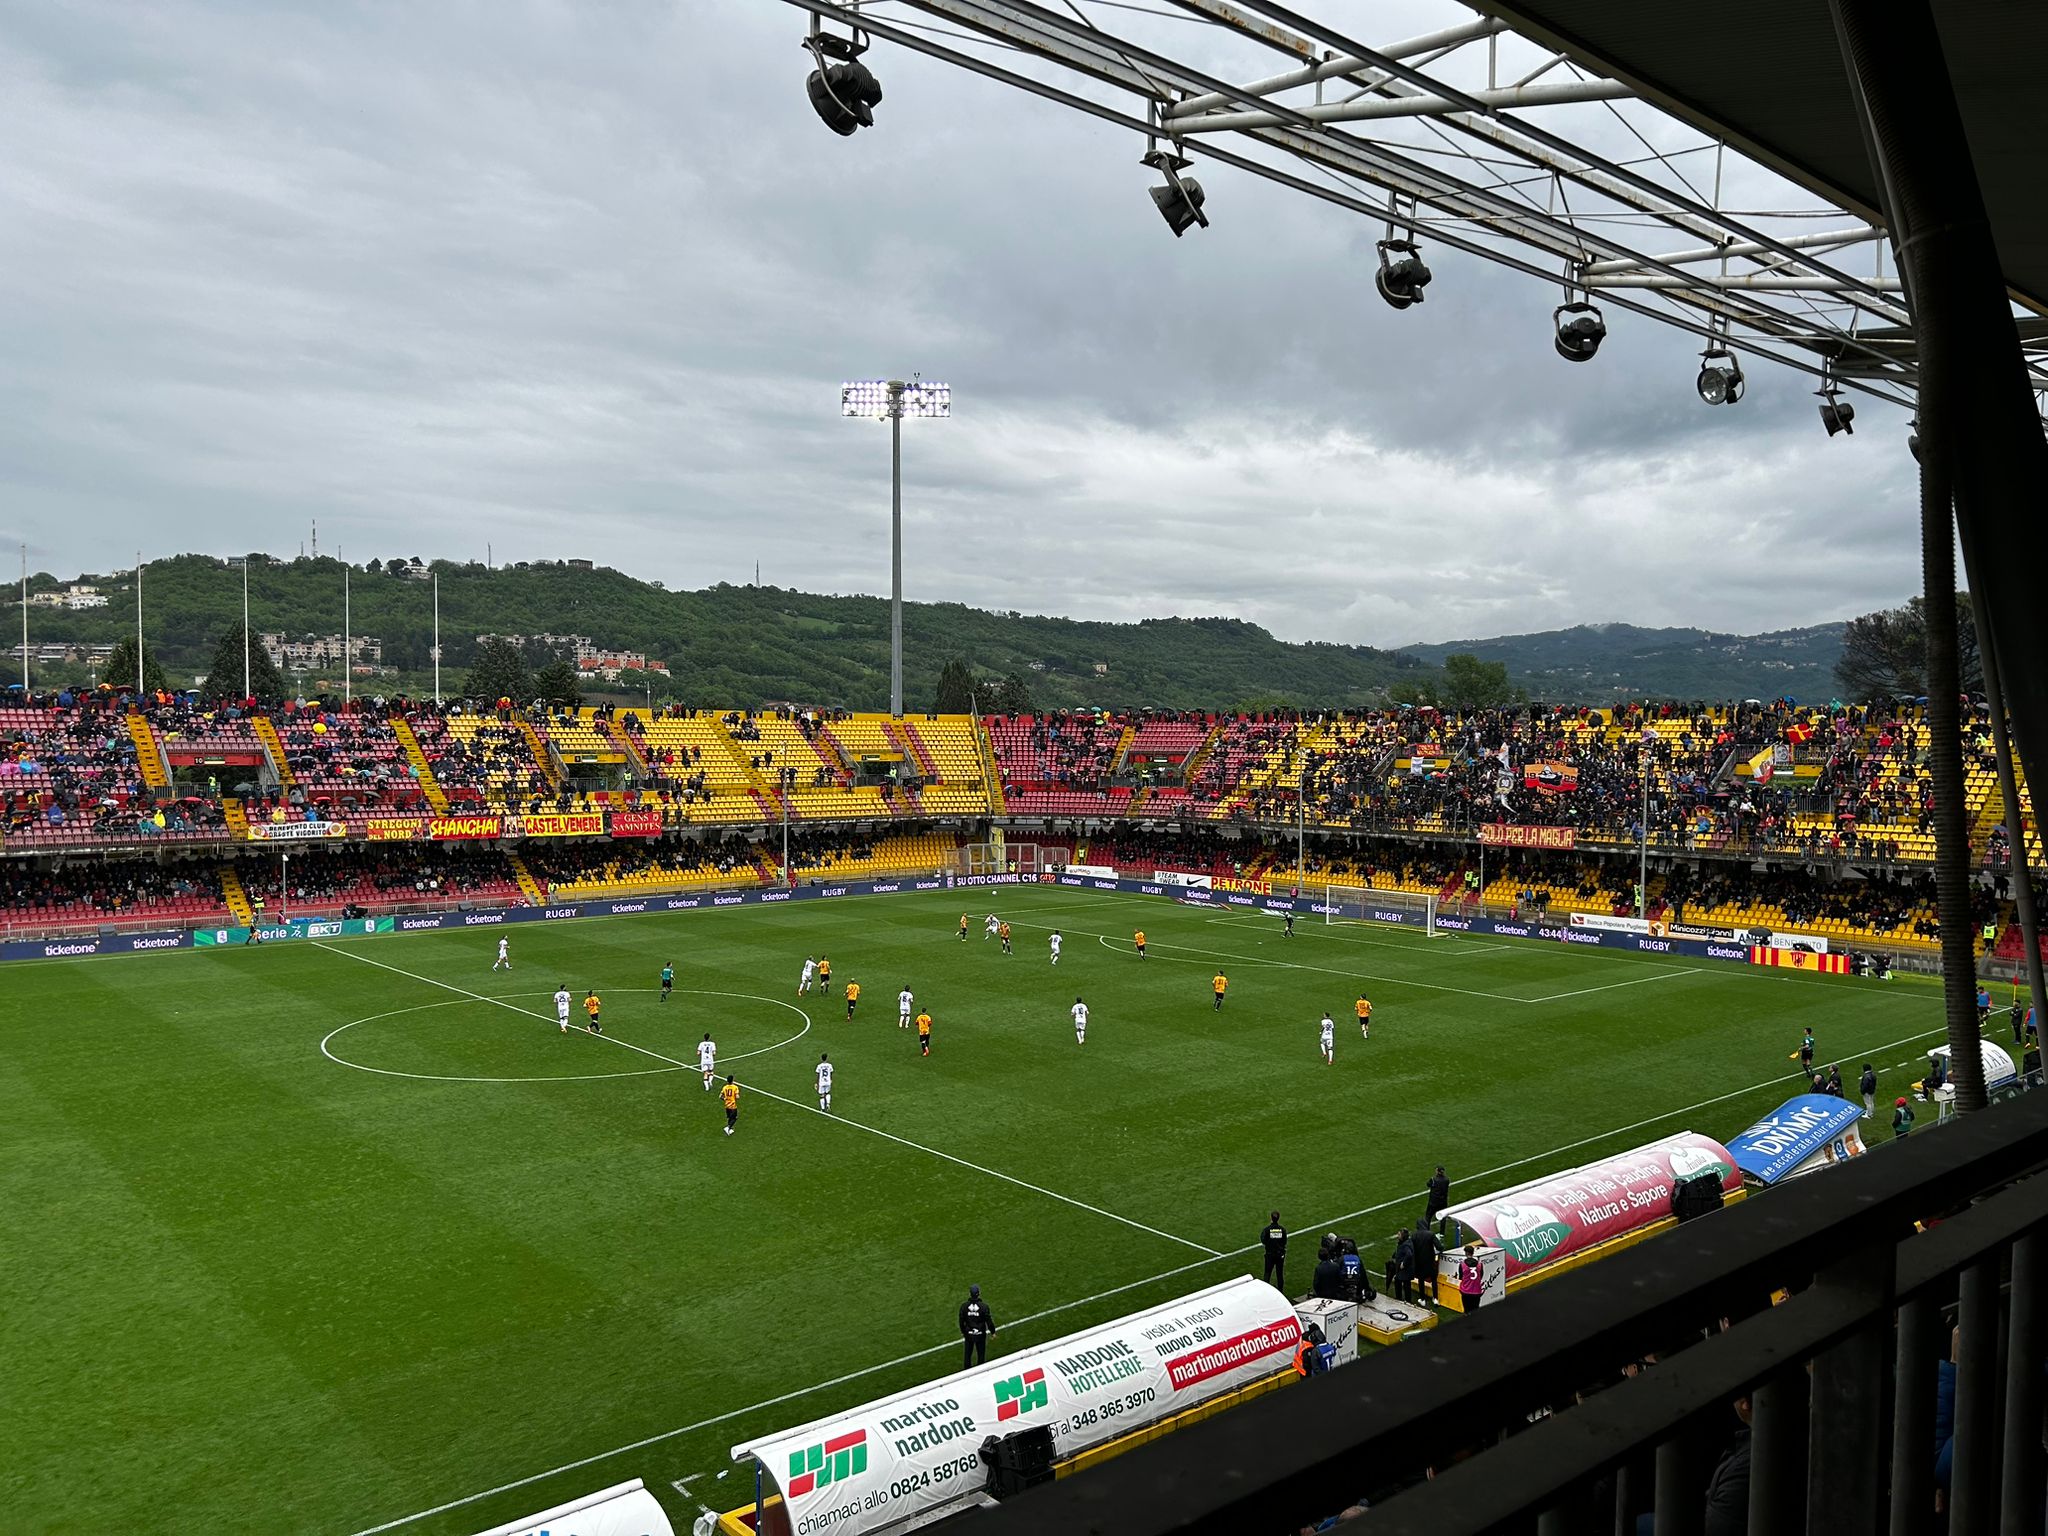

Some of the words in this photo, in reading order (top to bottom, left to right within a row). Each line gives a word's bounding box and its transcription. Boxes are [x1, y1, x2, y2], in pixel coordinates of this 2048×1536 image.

[368, 819, 422, 829] STREGONI
[623, 814, 649, 822] GENS
[269, 823, 308, 832] BENEVENTO
[308, 822, 327, 830] CLUB
[431, 818, 498, 837] SHANGHAI
[612, 822, 661, 832] SAMNITES
[383, 829, 412, 839] NORD
[1525, 827, 1538, 845] LA
[1539, 828, 1573, 847] MAGLIA
[916, 881, 940, 889] ticketone
[957, 876, 966, 886] SU
[967, 876, 986, 885] OTTO
[986, 873, 1021, 884] CHANNEL
[1021, 873, 1038, 883] C16
[822, 887, 847, 897] RUGBY
[873, 883, 899, 893] ticketone
[1142, 885, 1163, 895] RUGBY
[1211, 877, 1271, 896] PETRONE
[714, 895, 743, 905] ticketone
[761, 892, 790, 902] ticketone
[1186, 889, 1212, 900] ticketone
[1228, 894, 1253, 905] ticketone
[611, 904, 645, 914] ticketone
[668, 899, 699, 909] ticketone
[1267, 898, 1293, 910] ticketone
[465, 914, 502, 925] ticketone
[546, 908, 577, 919] RUGBY
[1375, 911, 1403, 922] RUGBY
[310, 925, 340, 935] BKT
[403, 919, 440, 929] ticketone
[1494, 923, 1528, 936] ticketone
[1587, 918, 1602, 926] Banca
[1603, 921, 1626, 930] Popolare
[1626, 922, 1648, 931] Pugliese
[1538, 928, 1562, 938] 43:44
[1568, 931, 1600, 943] ticketone
[1669, 924, 1706, 936] Minicozzi
[1706, 928, 1733, 938] ianni
[133, 937, 180, 949] ticketone
[1639, 939, 1671, 952] RUGBY
[45, 944, 96, 956] ticketone
[1707, 945, 1744, 959] ticketone
[1761, 1165, 1776, 1177] we
[1775, 1138, 1813, 1169] accelerate
[1810, 1125, 1828, 1143] your
[1825, 1104, 1856, 1129] advance
[1552, 1186, 1588, 1208] Dalla
[1584, 1176, 1617, 1198] Valle
[1613, 1164, 1662, 1187] Caudina
[1577, 1201, 1621, 1227] Natura
[1620, 1199, 1629, 1211] e
[1626, 1183, 1668, 1209] Sapore
[1512, 1227, 1560, 1262] MAURO
[1346, 1266, 1358, 1275] 16
[1469, 1266, 1478, 1280] 3
[1140, 1322, 1176, 1341] visita
[1176, 1316, 1184, 1330] il
[1185, 1305, 1224, 1326] nostro
[1154, 1333, 1194, 1357] nuovo
[1195, 1325, 1217, 1343] sito
[1053, 1339, 1135, 1377] NARDONE
[1172, 1322, 1298, 1383] martinonardone.com
[880, 1398, 960, 1434] martino
[1061, 1418, 1071, 1436] al
[1072, 1408, 1098, 1430] 348
[1099, 1399, 1124, 1420] 365
[1125, 1387, 1156, 1410] 3970
[894, 1416, 977, 1458] nardone
[798, 1497, 862, 1536] chiamaci
[865, 1490, 889, 1510] allo
[890, 1471, 931, 1499] 0824
[933, 1453, 979, 1484] 58768
